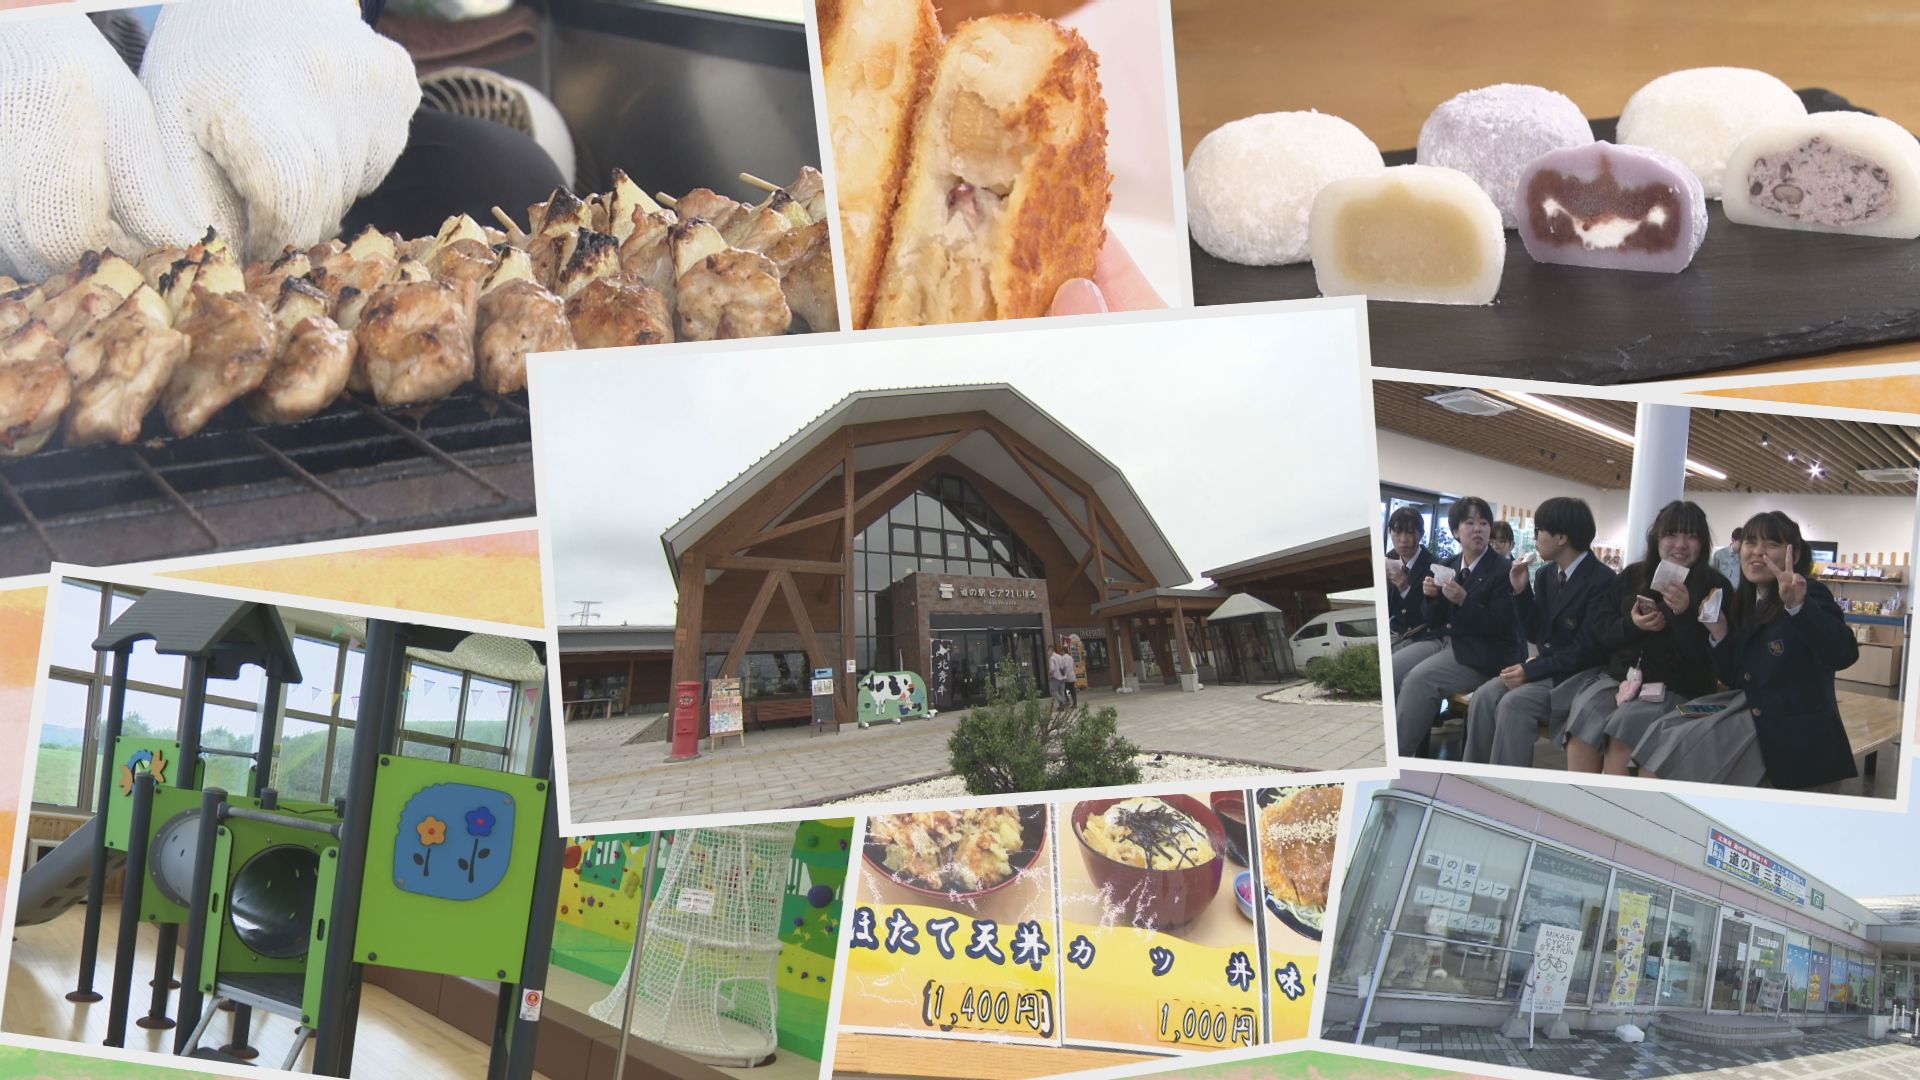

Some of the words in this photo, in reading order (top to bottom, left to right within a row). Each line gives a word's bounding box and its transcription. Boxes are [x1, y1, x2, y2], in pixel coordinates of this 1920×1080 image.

[1426, 853, 1477, 875] 道の駅
[1729, 851, 1760, 876] 道の駅
[1763, 867, 1782, 887] 三笠
[1442, 875, 1506, 896] スタンプ
[1420, 890, 1467, 908] レンタ
[1435, 912, 1497, 931] サイクル
[851, 907, 1050, 971] ほたて天丼
[1545, 930, 1575, 942] MIKASA
[932, 983, 1042, 1031] 1,400円
[1159, 1002, 1258, 1047] 1,000円
